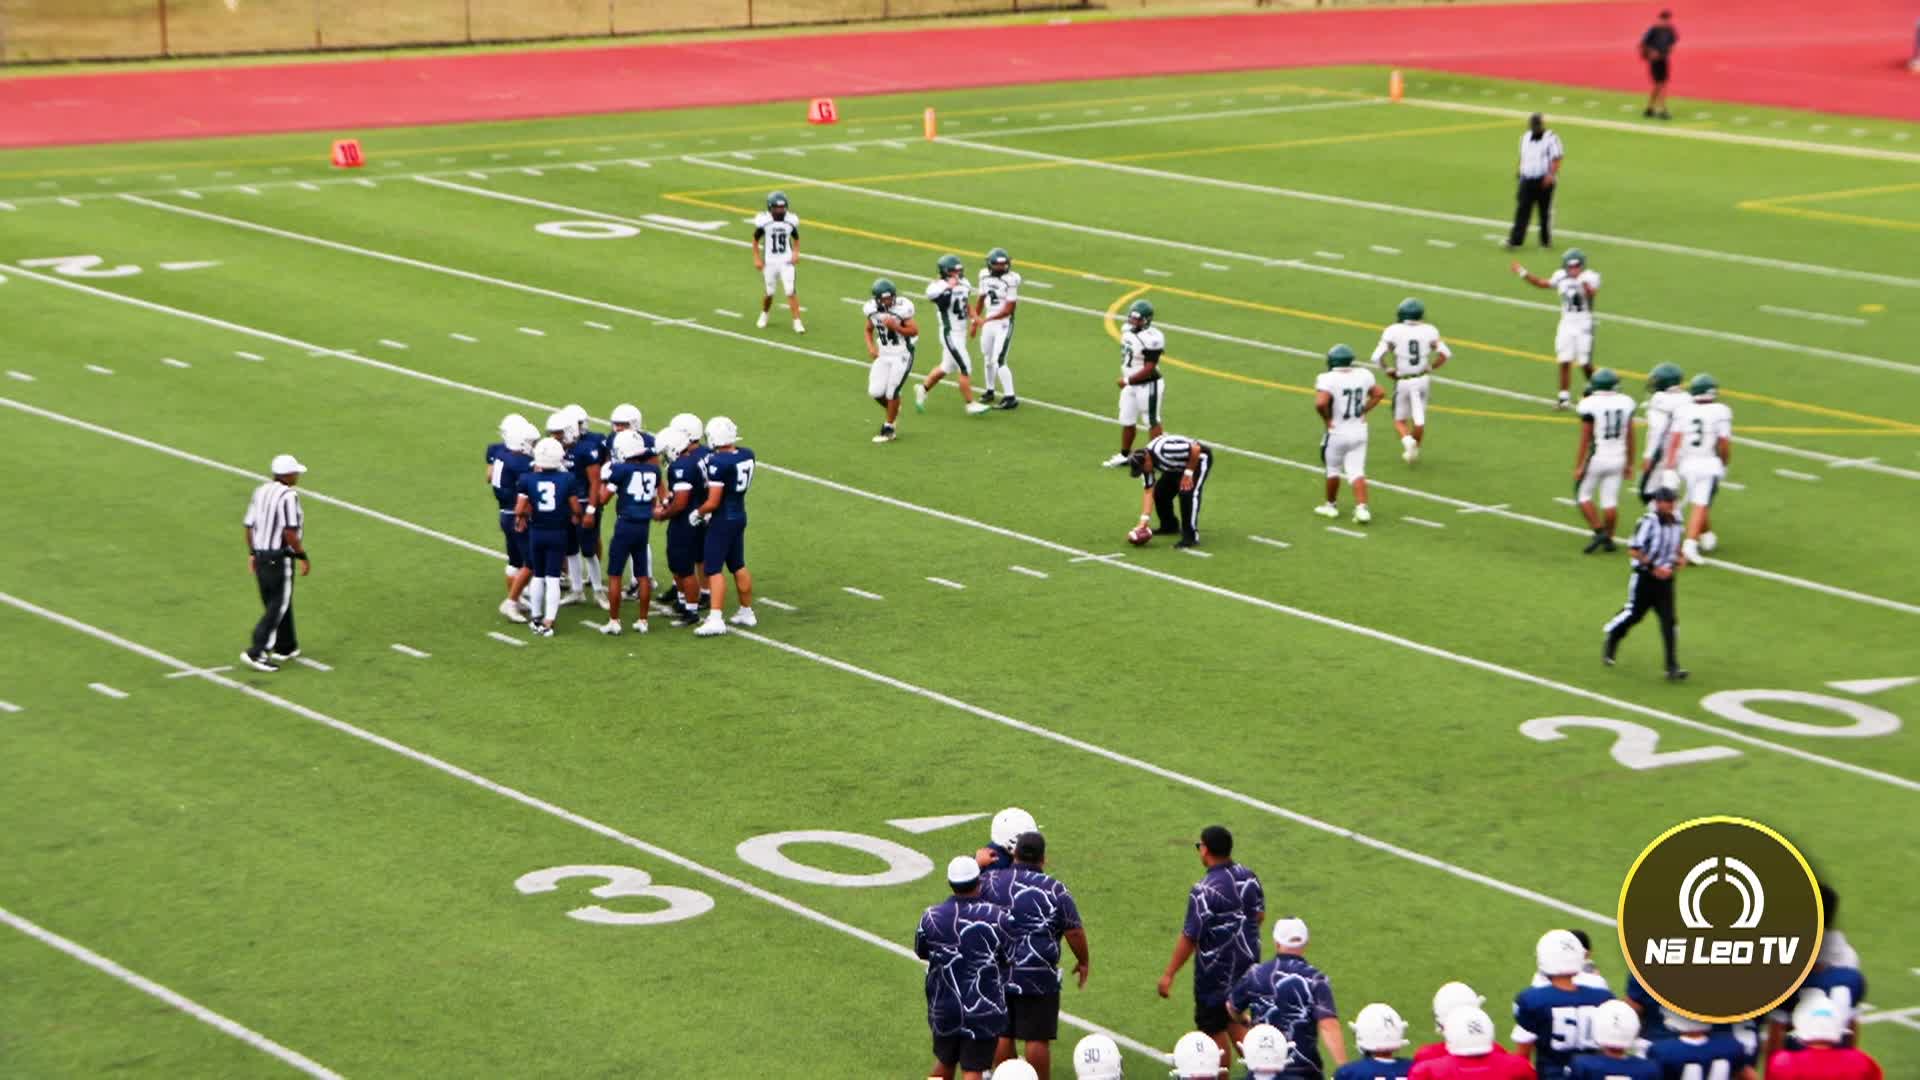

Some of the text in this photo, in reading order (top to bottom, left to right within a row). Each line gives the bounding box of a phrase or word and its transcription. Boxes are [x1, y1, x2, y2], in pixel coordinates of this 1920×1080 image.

[818, 103, 833, 118] G
[339, 144, 359, 161] 10
[771, 233, 786, 254] 19
[1408, 339, 1420, 366] 9
[1691, 418, 1703, 447] 3
[537, 481, 556, 512] 3
[627, 471, 657, 502] 43
[514, 829, 936, 925] 30
